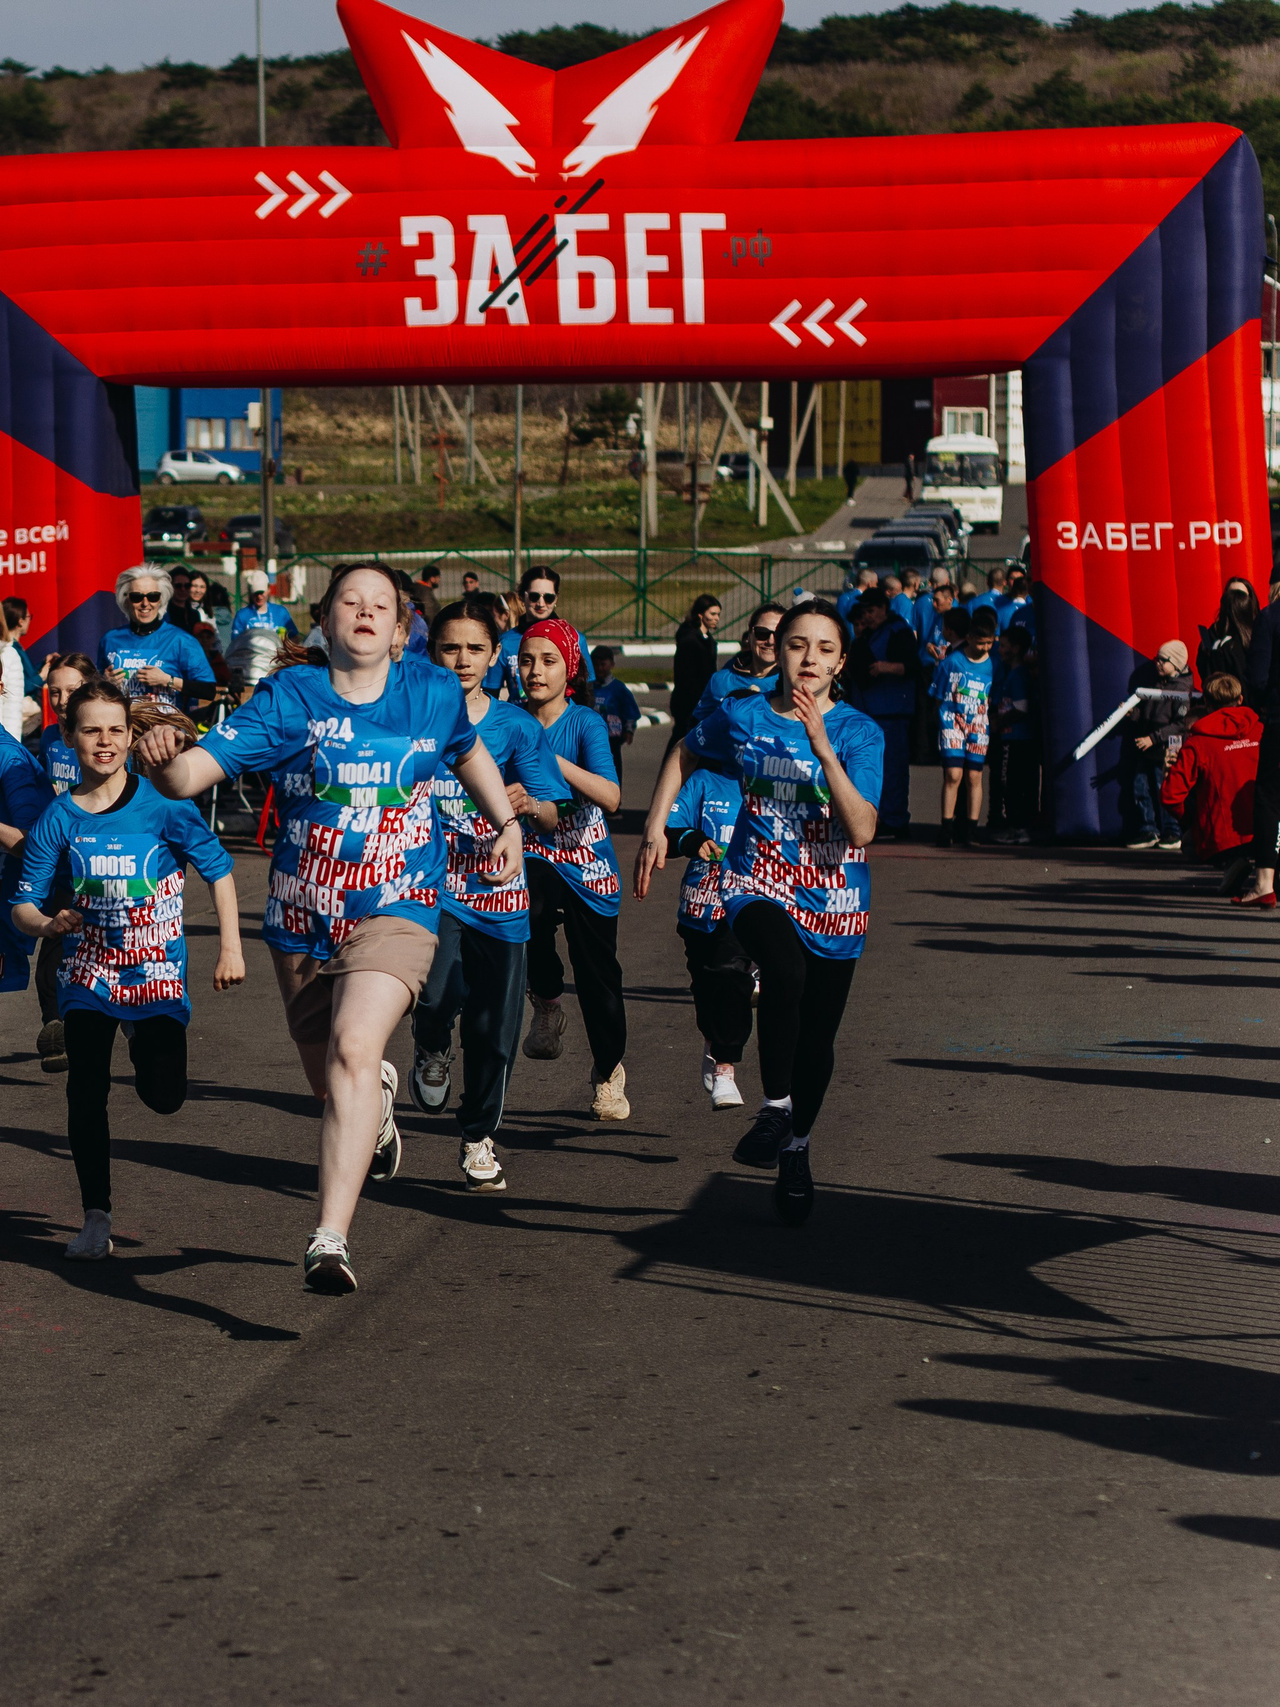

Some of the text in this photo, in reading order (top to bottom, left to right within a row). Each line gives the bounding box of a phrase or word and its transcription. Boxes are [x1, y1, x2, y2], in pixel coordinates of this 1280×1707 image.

[15, 520, 69, 545] всей
[1056, 519, 1242, 551] ЗАБЕГ.РФ
[52, 761, 76, 781] 10034
[336, 761, 391, 785] 10041
[763, 756, 814, 781] 10005
[89, 855, 137, 876] 10015
[297, 848, 407, 891] #ГОРДОСТЬ
[751, 857, 847, 889] #ГОРДОСТЬ
[826, 887, 861, 912] 2024
